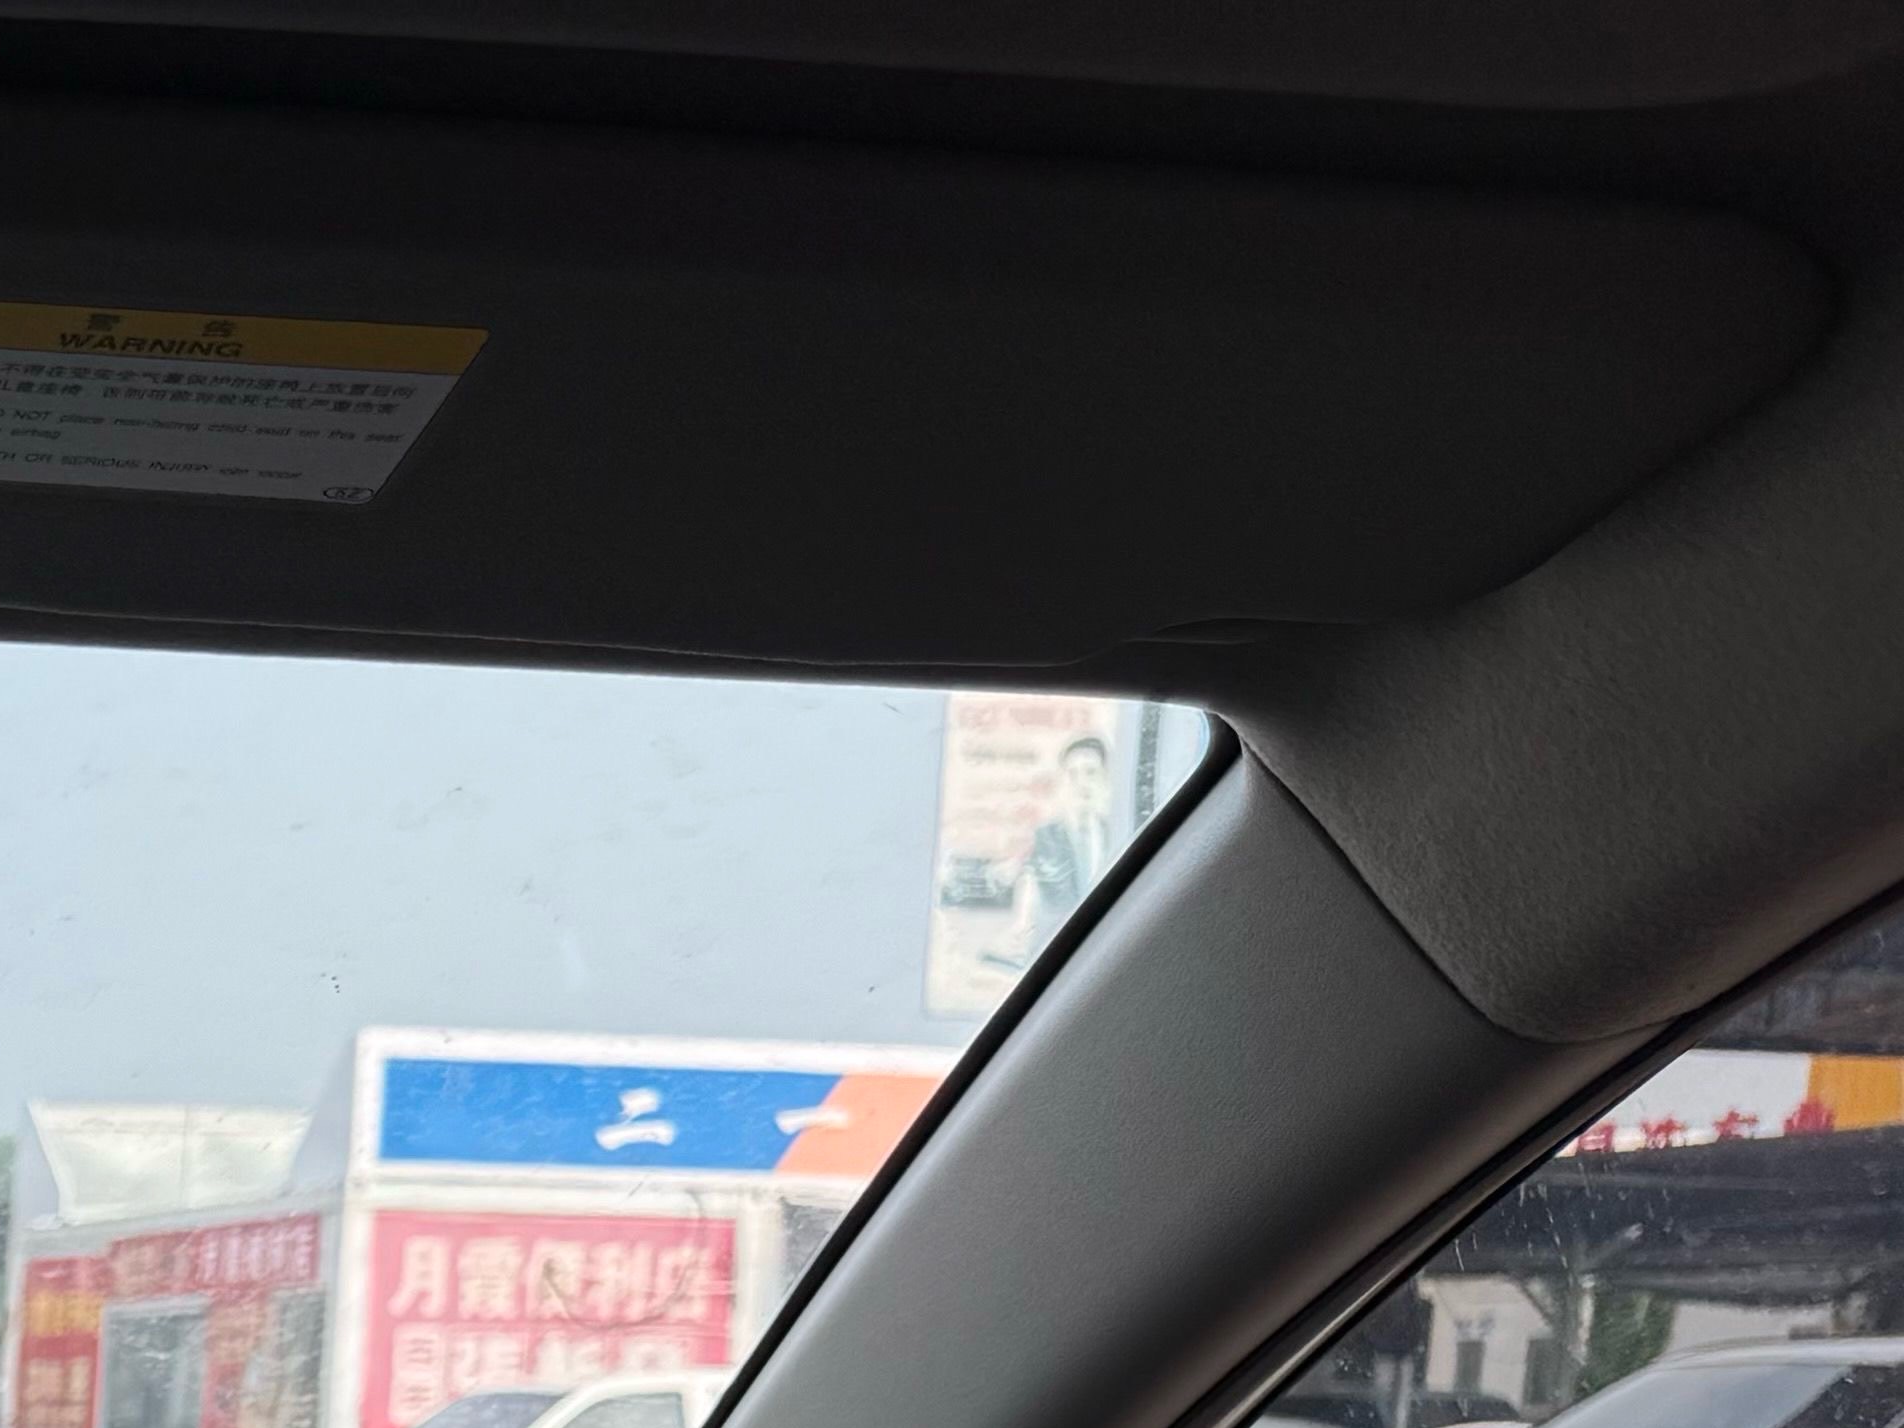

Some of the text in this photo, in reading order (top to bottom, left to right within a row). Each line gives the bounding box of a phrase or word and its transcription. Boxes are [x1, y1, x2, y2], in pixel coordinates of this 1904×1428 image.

[59, 332, 244, 359] WARNING
[13, 410, 53, 421] NOT
[24, 452, 54, 464] OR
[387, 1233, 712, 1322] 月霞便利店
